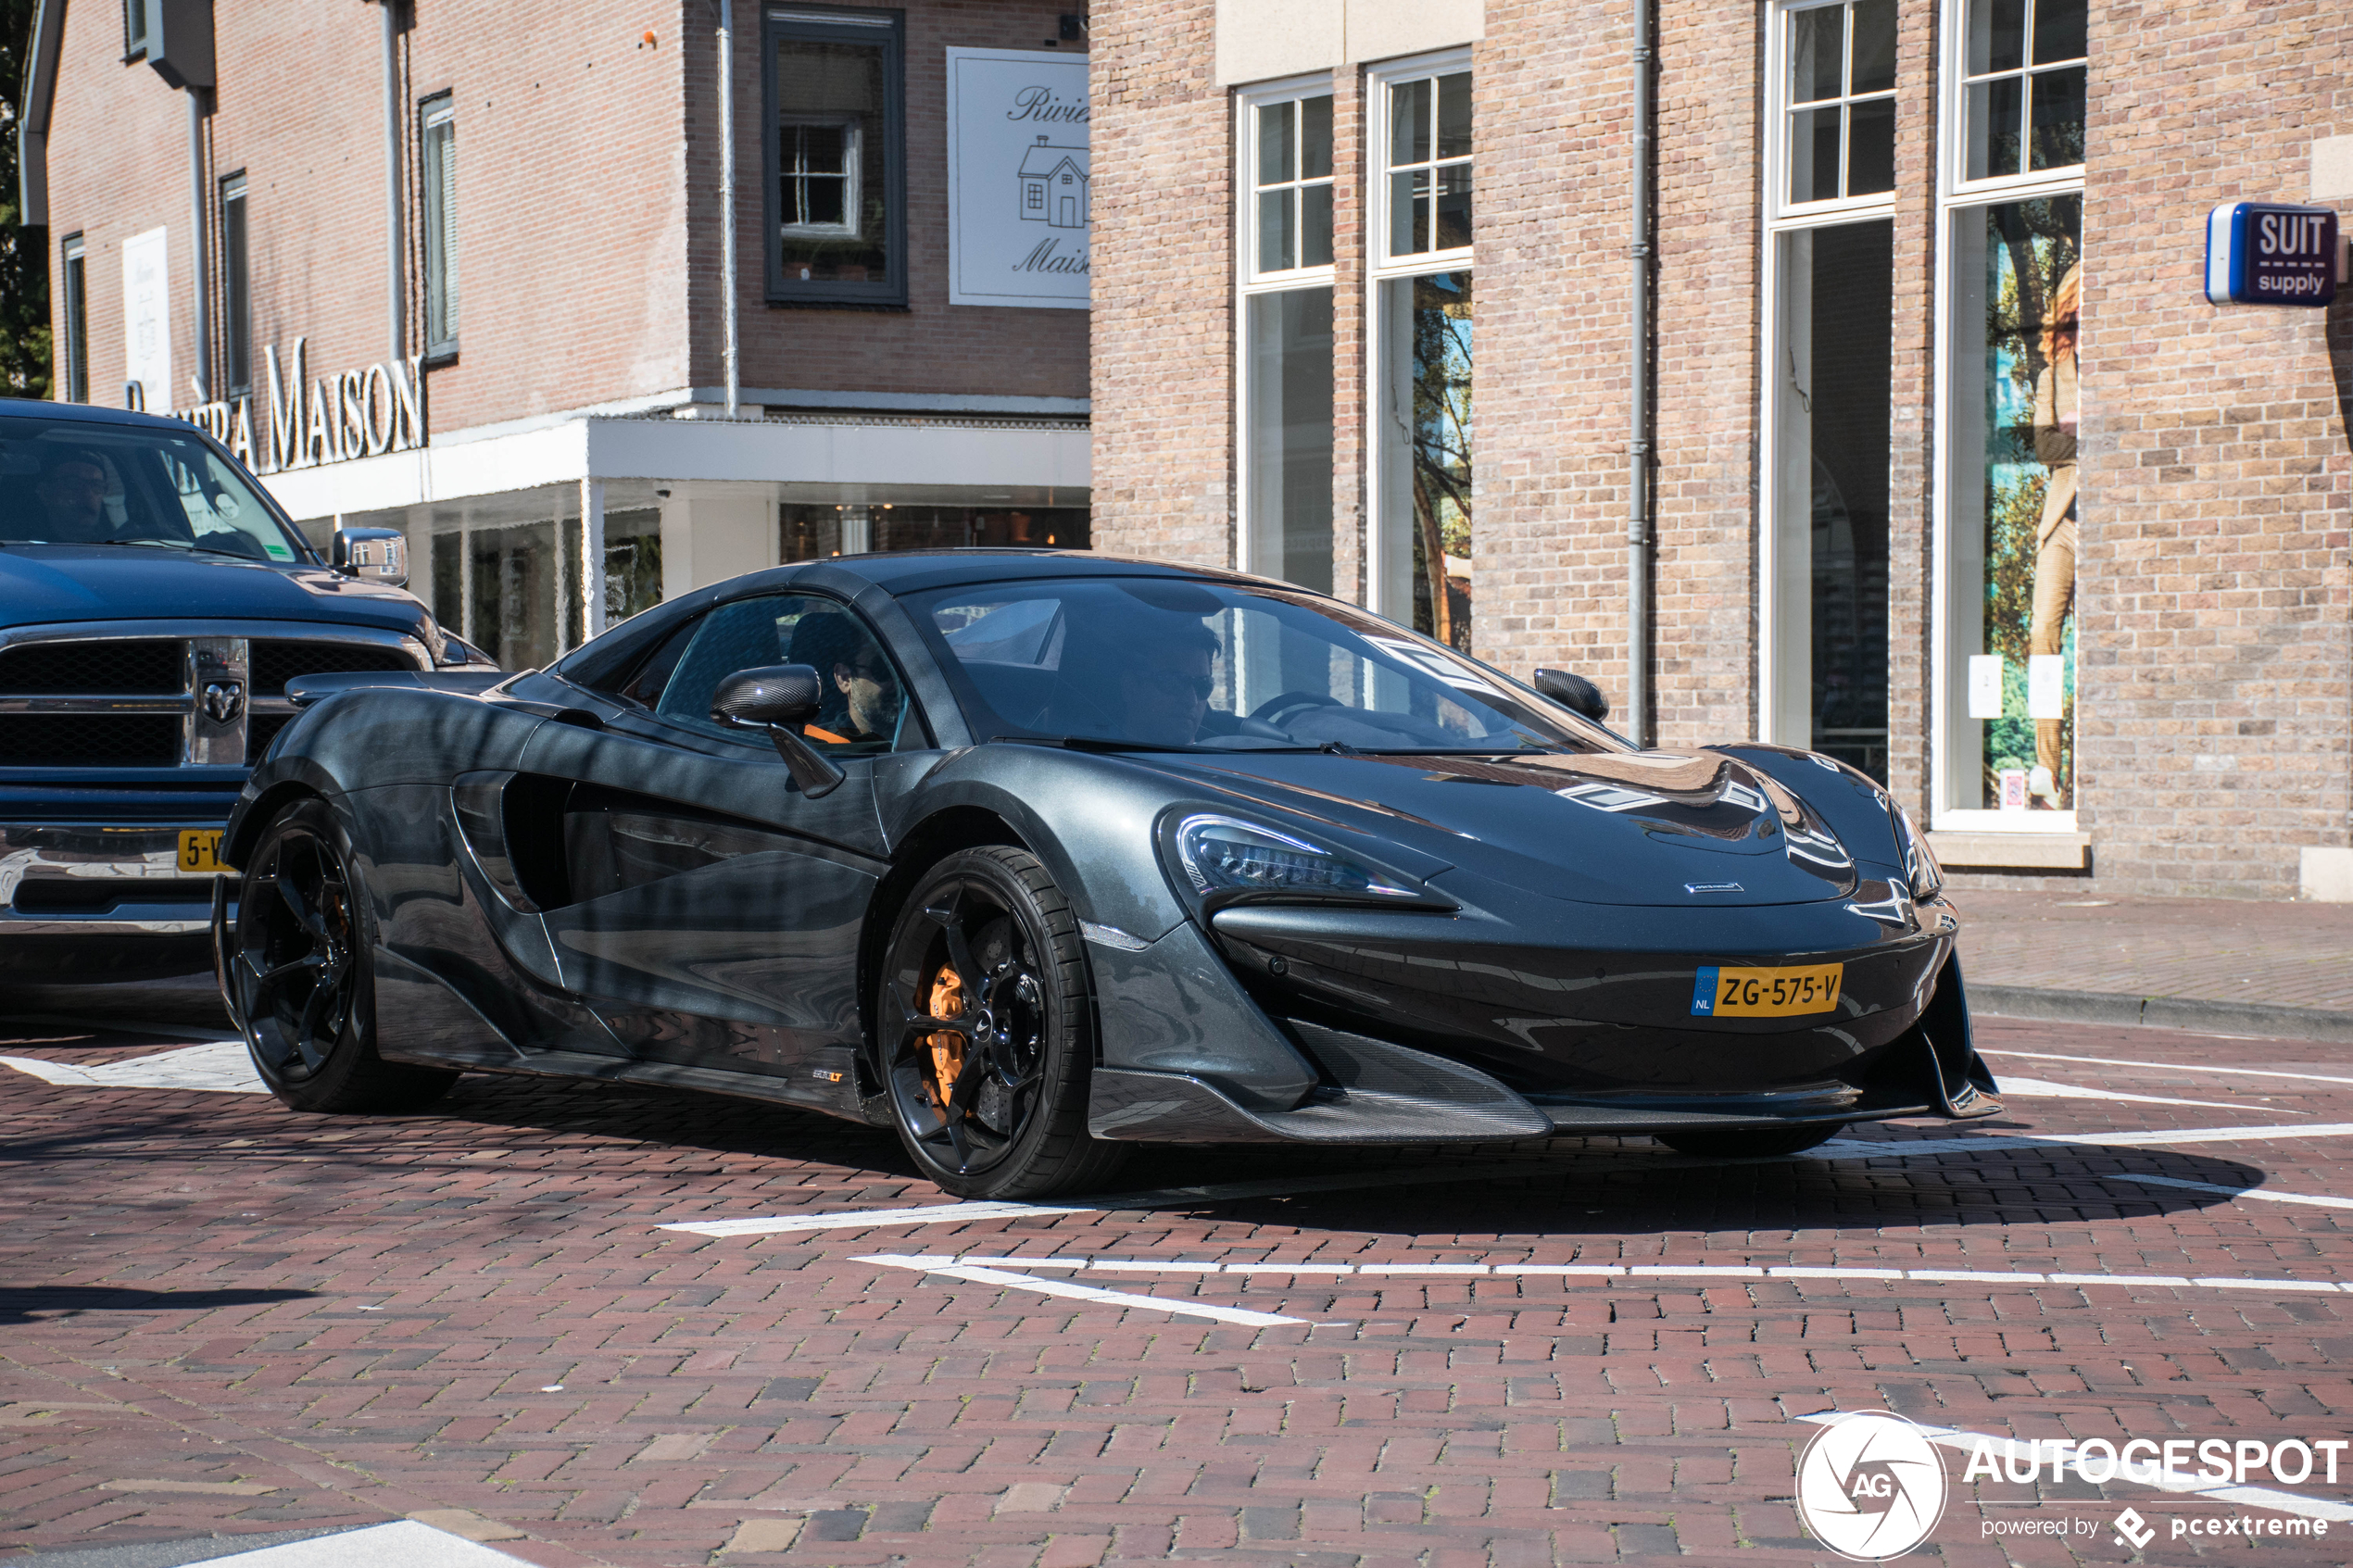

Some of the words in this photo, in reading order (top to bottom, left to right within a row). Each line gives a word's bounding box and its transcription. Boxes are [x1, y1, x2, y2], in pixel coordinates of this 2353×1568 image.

[1006, 85, 1090, 123] Rivie
[2259, 214, 2327, 255] SUIT
[2259, 272, 2325, 296] supply
[1695, 999, 1710, 1010] NL
[1721, 974, 1838, 1006] ZG-575-V
